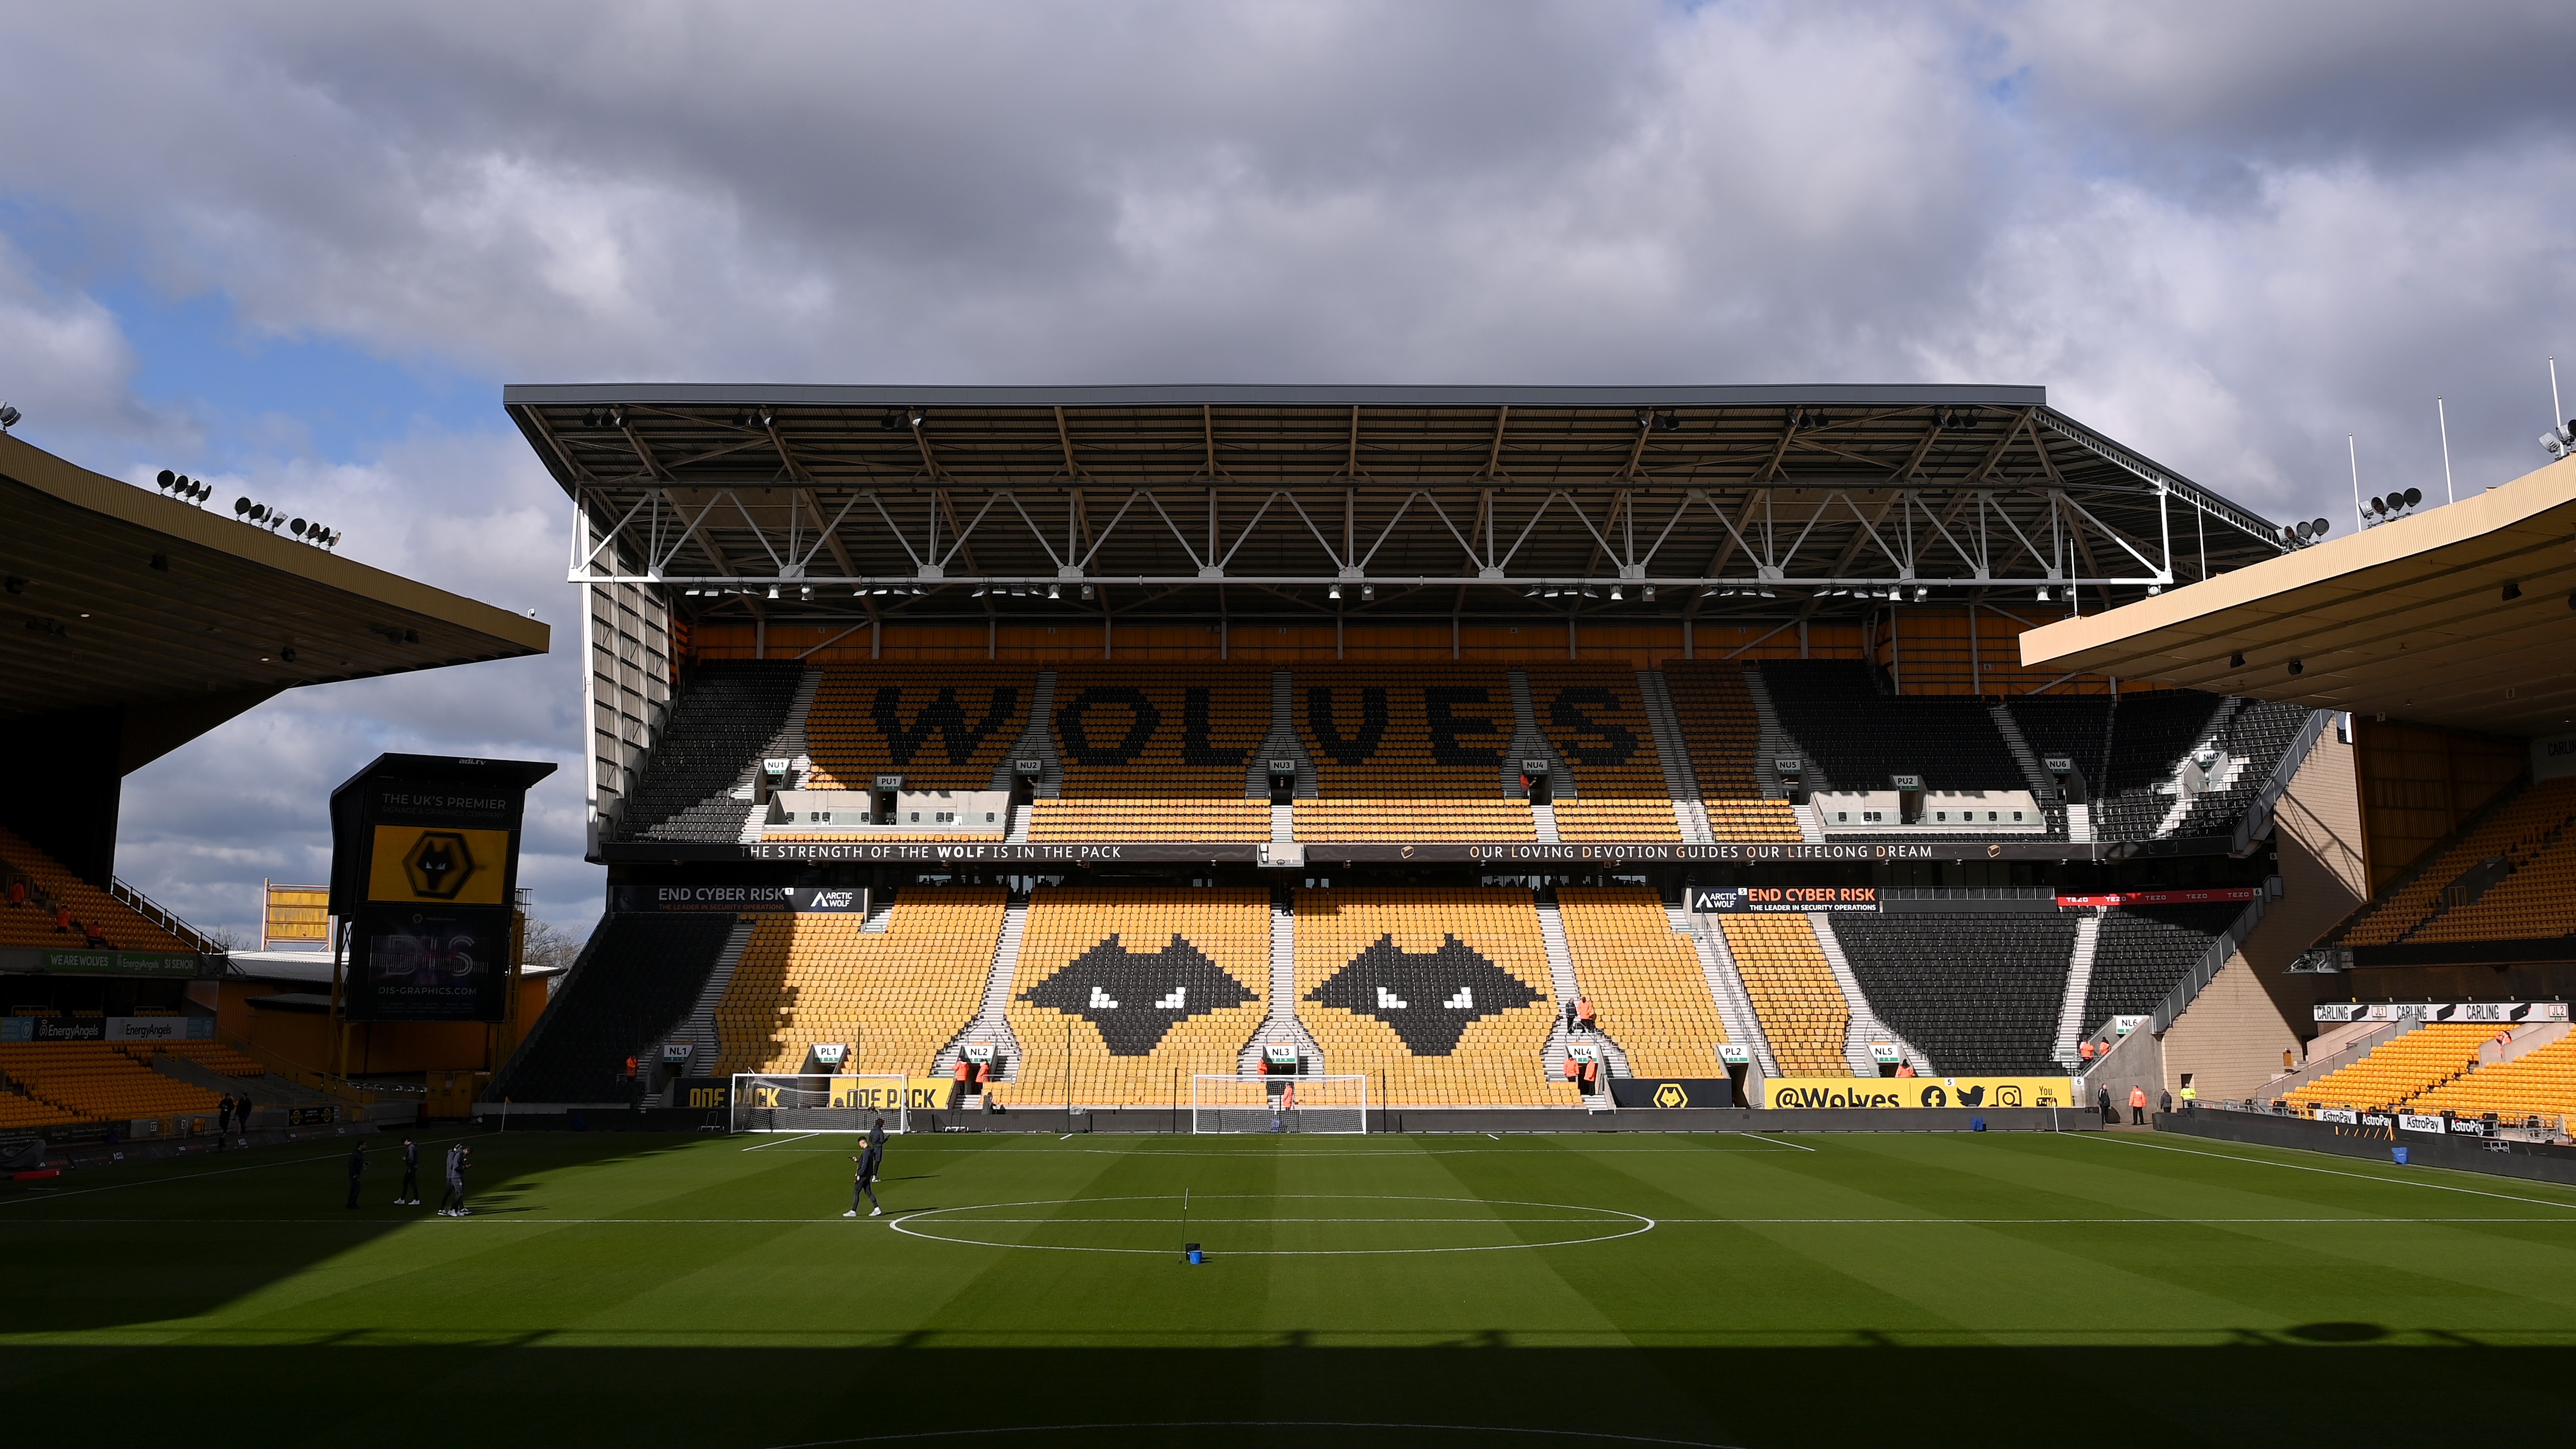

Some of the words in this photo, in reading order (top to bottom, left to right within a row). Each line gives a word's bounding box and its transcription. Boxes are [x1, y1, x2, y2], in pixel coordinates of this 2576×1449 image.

[870, 686, 1639, 765] WOLVES
[382, 793, 409, 804] THE
[413, 795, 443, 807] UK'S
[447, 797, 506, 809] PREMIER
[381, 805, 416, 814] SIGNAGE
[425, 808, 464, 816] GRAPHICS
[466, 810, 505, 818] COMPANY
[740, 847, 769, 858] THE
[778, 847, 862, 858] STRENGTH
[871, 847, 890, 858] OF
[898, 847, 928, 858] THE
[937, 847, 984, 858] WOLF
[993, 847, 1009, 858] IS
[1017, 847, 1035, 858] IN
[1043, 847, 1073, 858] THE
[1082, 847, 1121, 858] PACK
[1469, 847, 1502, 858] OUR
[1511, 847, 1574, 858] LOVING
[1582, 847, 1667, 858] DEVOTION
[1676, 847, 1738, 858] GUIDES
[1746, 847, 1780, 858] OUR
[1787, 847, 1867, 858] LIFELONG
[1877, 847, 1932, 858] DREAM
[658, 888, 691, 900] END
[695, 888, 745, 900] CYBER
[750, 888, 785, 900] RISK
[1749, 889, 1782, 902] END
[1786, 889, 1836, 901] CYBER
[1841, 888, 1876, 901] RISK
[50, 955, 62, 965] WE
[63, 955, 78, 966] ARE
[79, 956, 109, 966] WOLVES
[123, 959, 159, 970] EnergyAngels
[172, 959, 194, 970] SENOR
[378, 987, 477, 995] DIS-GRAPHICS.COM
[2317, 1006, 2348, 1019] CARLING
[2375, 1007, 2384, 1016] JL1
[2396, 1006, 2427, 1020] CARLING
[2466, 1005, 2499, 1020] CARLING
[2551, 1006, 2565, 1015] JL2
[49, 1024, 99, 1039] EnergyAngels
[126, 1024, 172, 1038] EnergyAngels
[689, 1087, 726, 1107] ONE
[1775, 1087, 1899, 1107] @Wolves
[2039, 1086, 2052, 1095] You
[846, 1089, 882, 1107] ONE
[2323, 1111, 2352, 1124] AstroPay
[2363, 1113, 2392, 1127] AstroPay
[2407, 1116, 2438, 1133] AstroPay
[2451, 1119, 2484, 1136] AstroPay
